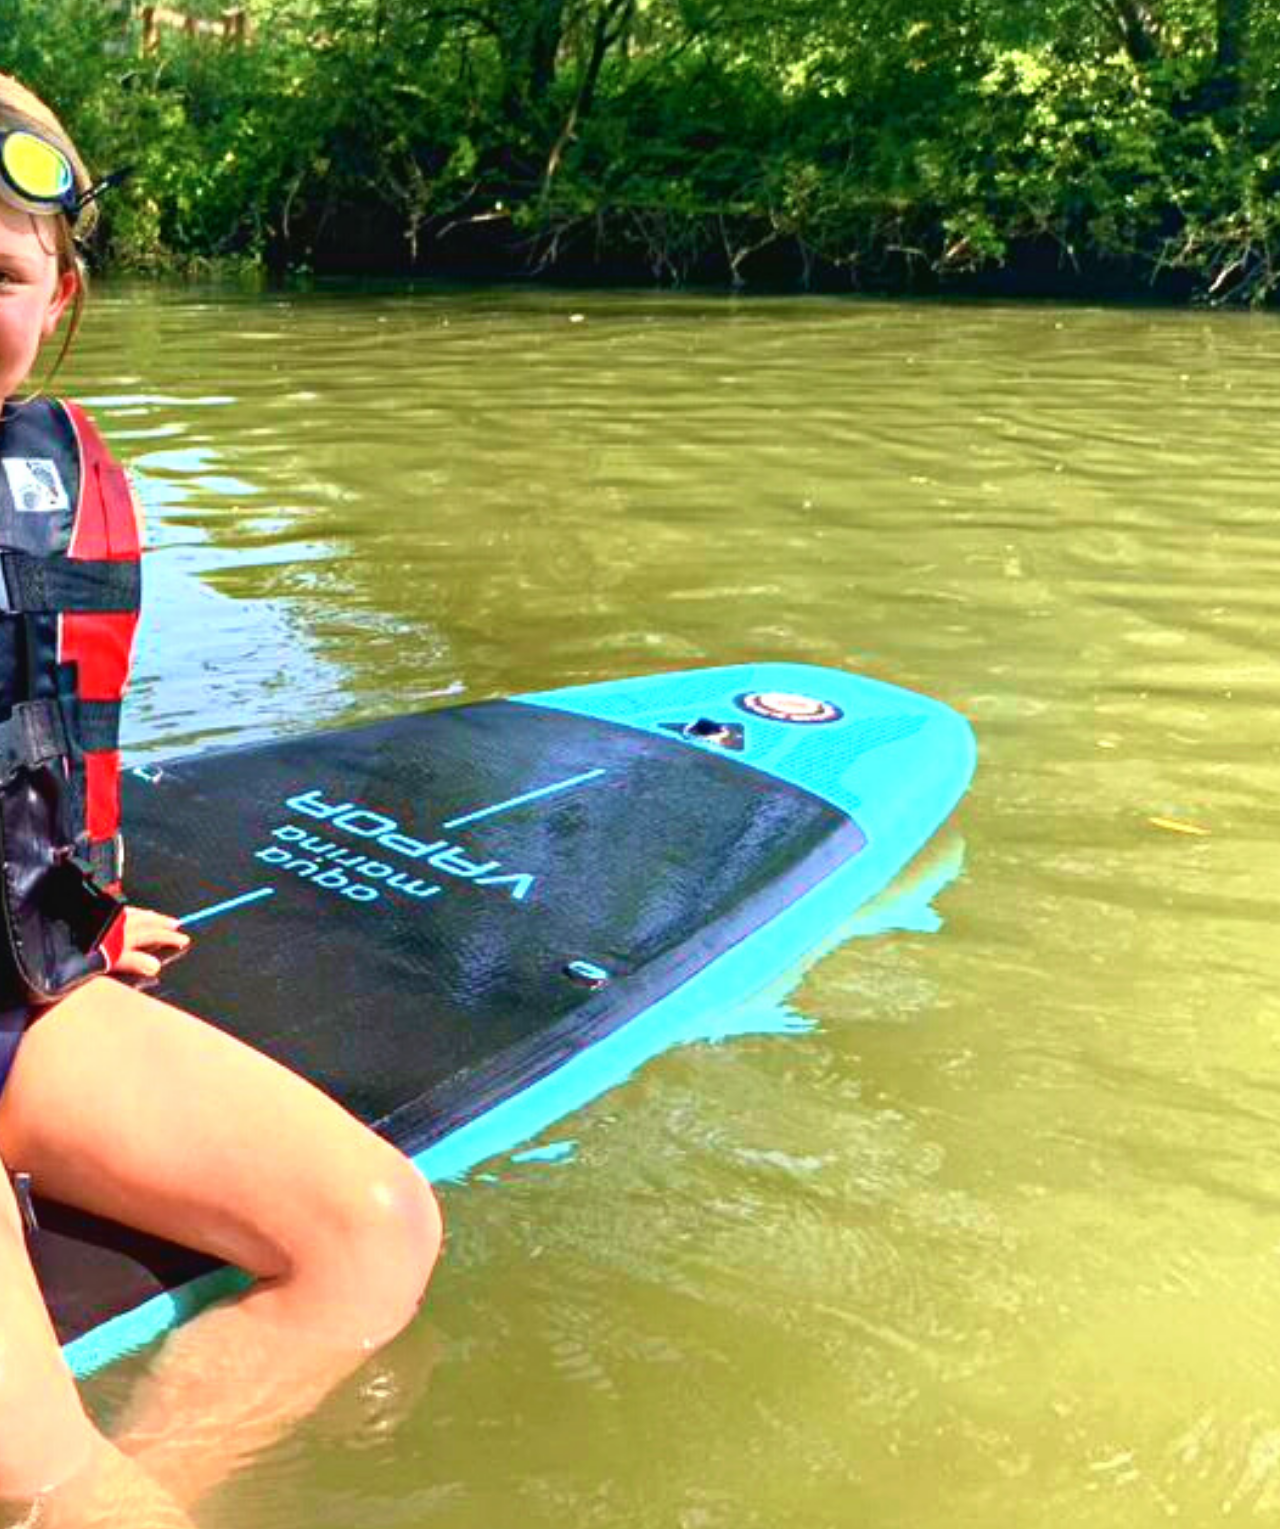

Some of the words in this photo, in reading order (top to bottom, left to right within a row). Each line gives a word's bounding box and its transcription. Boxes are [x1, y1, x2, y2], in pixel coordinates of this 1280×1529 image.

[254, 846, 380, 902] aqua
[271, 824, 442, 898] marina
[285, 789, 536, 901] VAPOR
